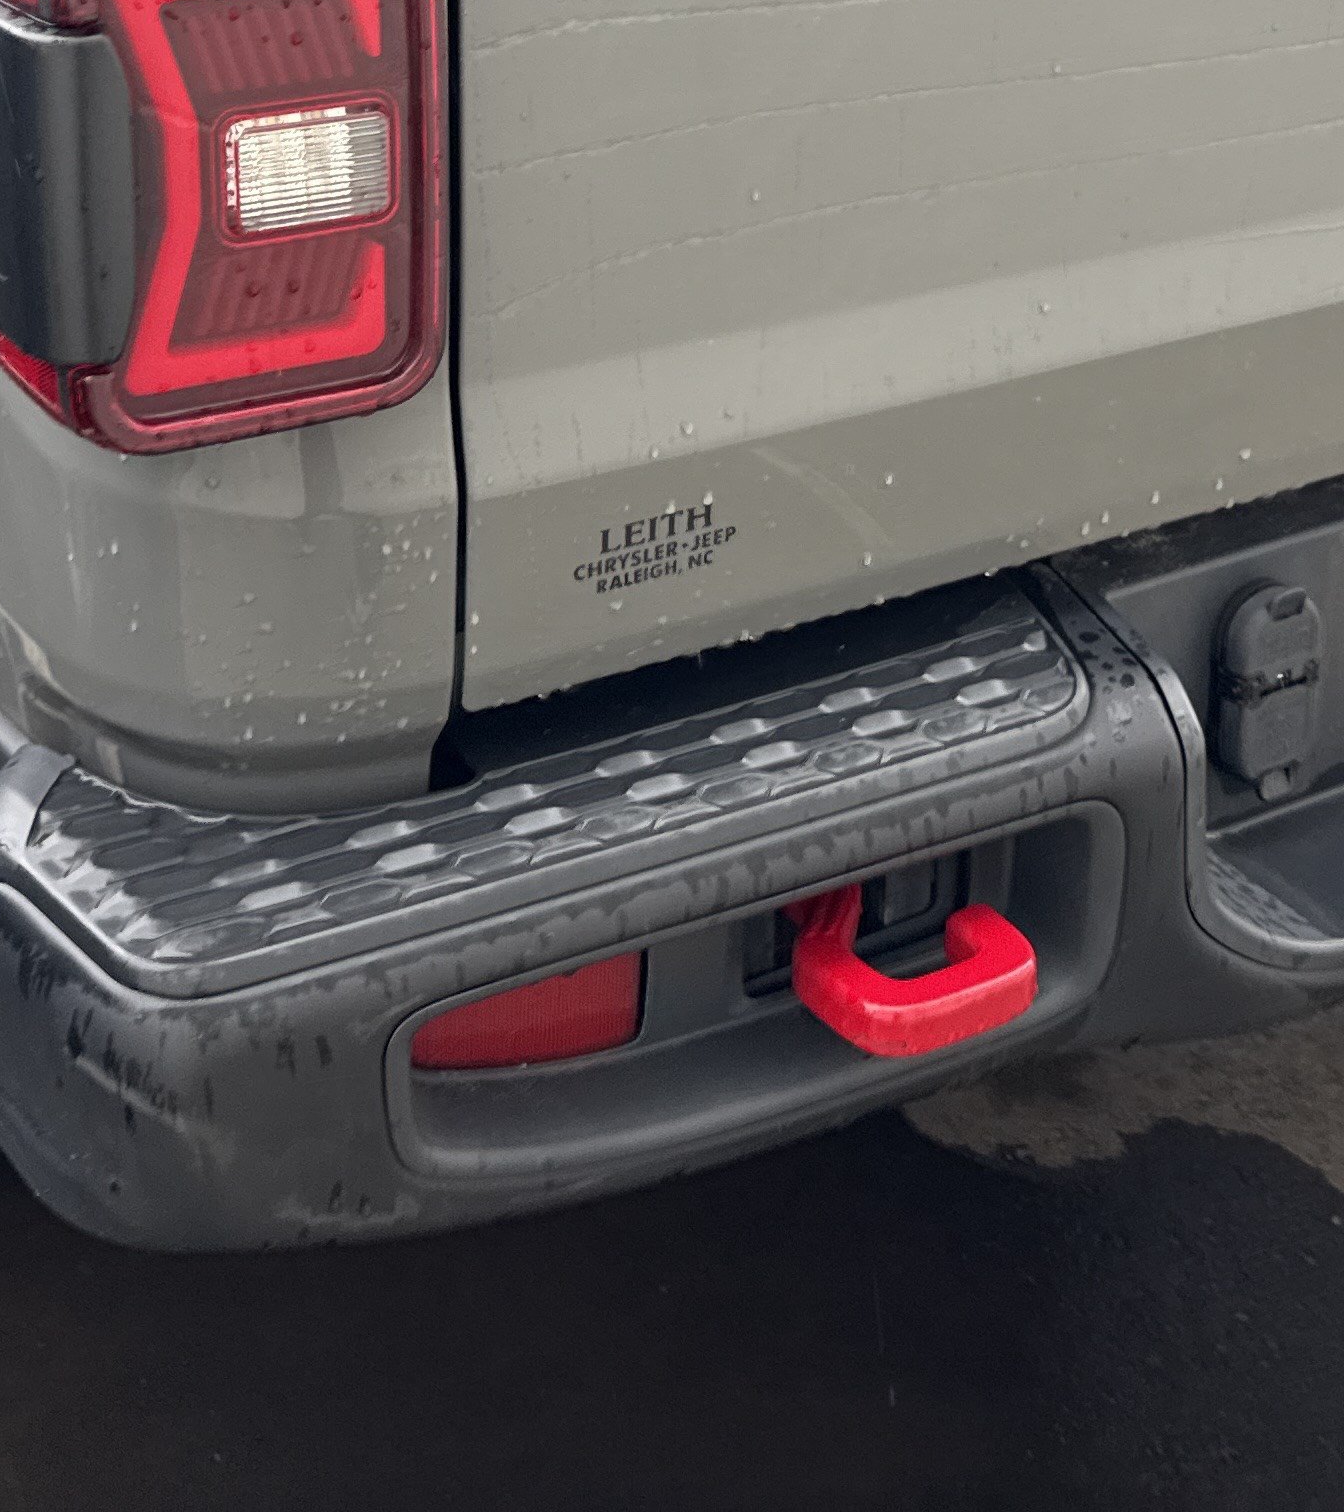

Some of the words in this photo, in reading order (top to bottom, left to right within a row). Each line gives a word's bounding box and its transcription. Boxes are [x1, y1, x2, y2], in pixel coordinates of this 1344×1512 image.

[600, 503, 713, 555] LEITH
[596, 560, 683, 594] RALEIGH,
[688, 549, 715, 571] NC
